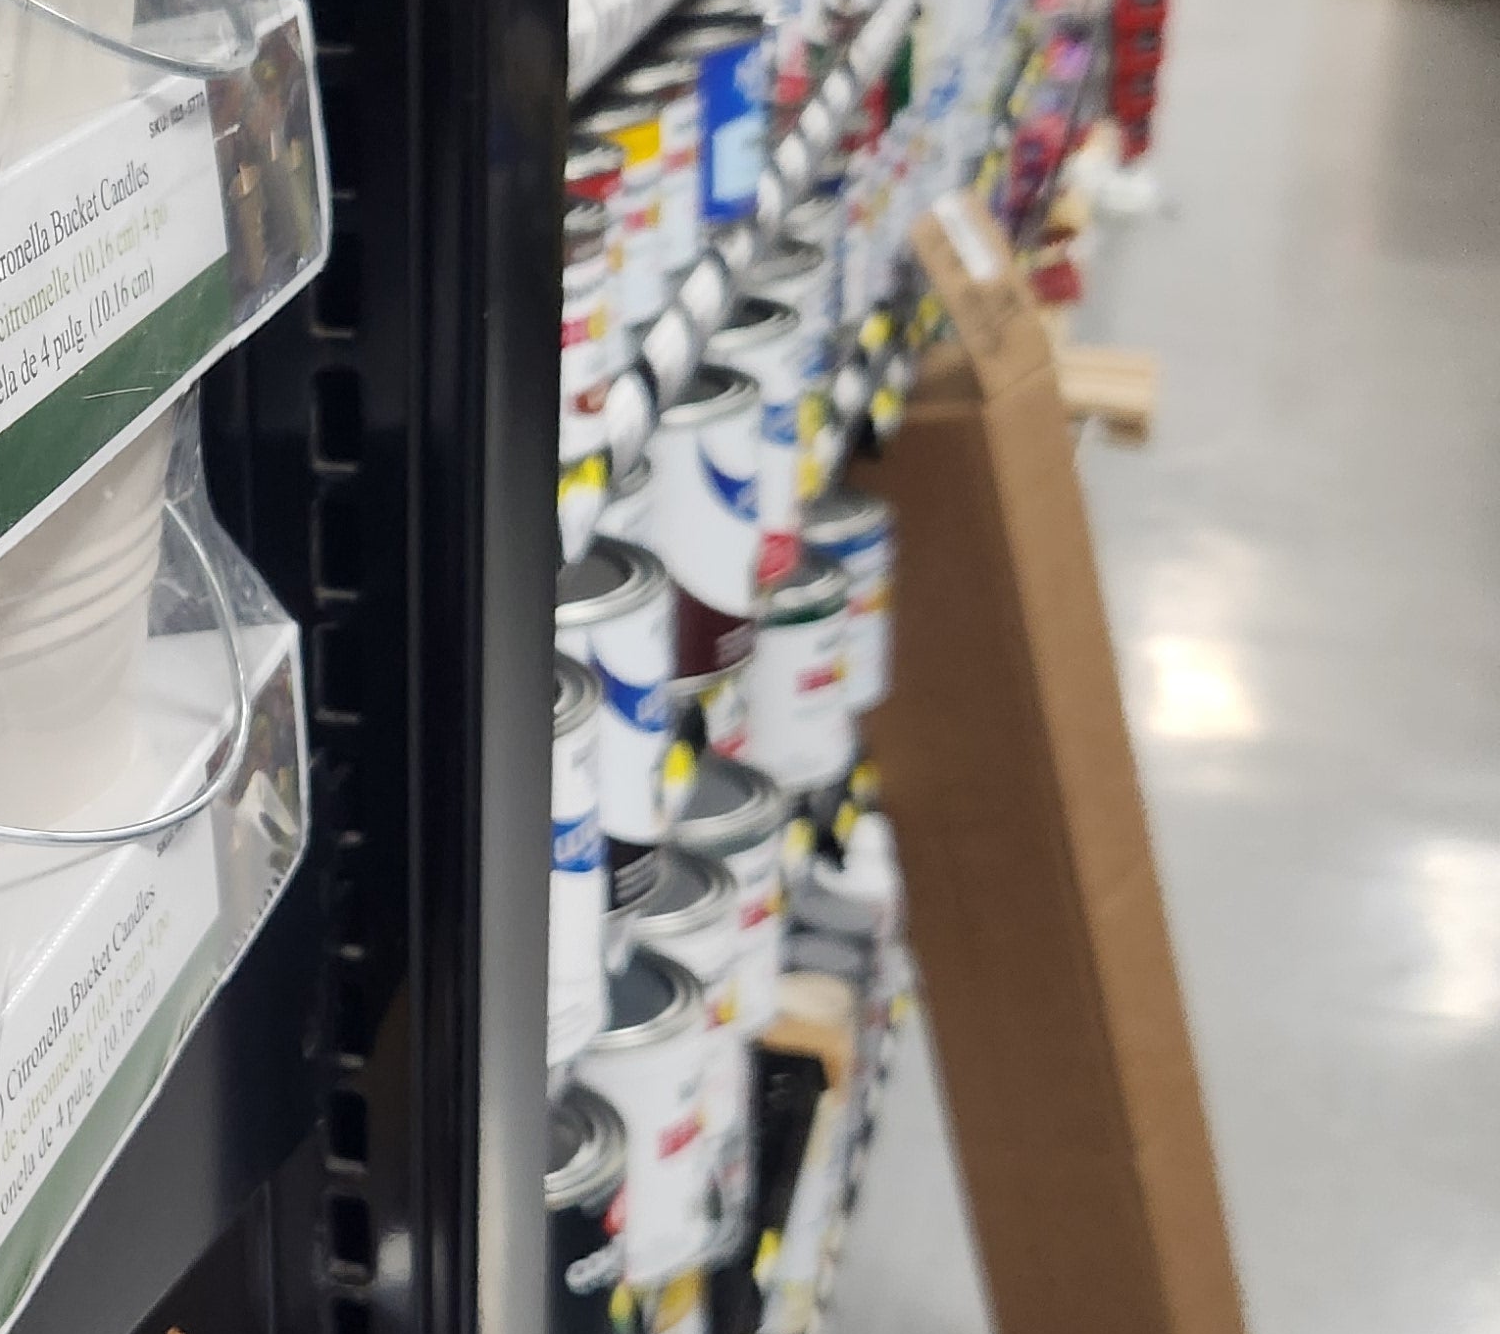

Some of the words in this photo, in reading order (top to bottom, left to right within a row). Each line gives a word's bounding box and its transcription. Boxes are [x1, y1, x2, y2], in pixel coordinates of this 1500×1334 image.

[51, 191, 100, 247] Bucket
[100, 160, 150, 211] Candles
[116, 217, 141, 257] cm)
[20, 348, 38, 386] de
[41, 334, 51, 368] 4
[52, 315, 88, 371] pulg.
[88, 274, 131, 340] (10.16
[131, 260, 155, 302] cm)
[6, 1004, 69, 1102] Citronella
[69, 942, 113, 1015] Bucket
[112, 883, 156, 952] Candles
[38, 1124, 54, 1160] de
[53, 1100, 66, 1129] 4
[135, 968, 157, 1015] cm)
[2, 1127, 17, 1165] de
